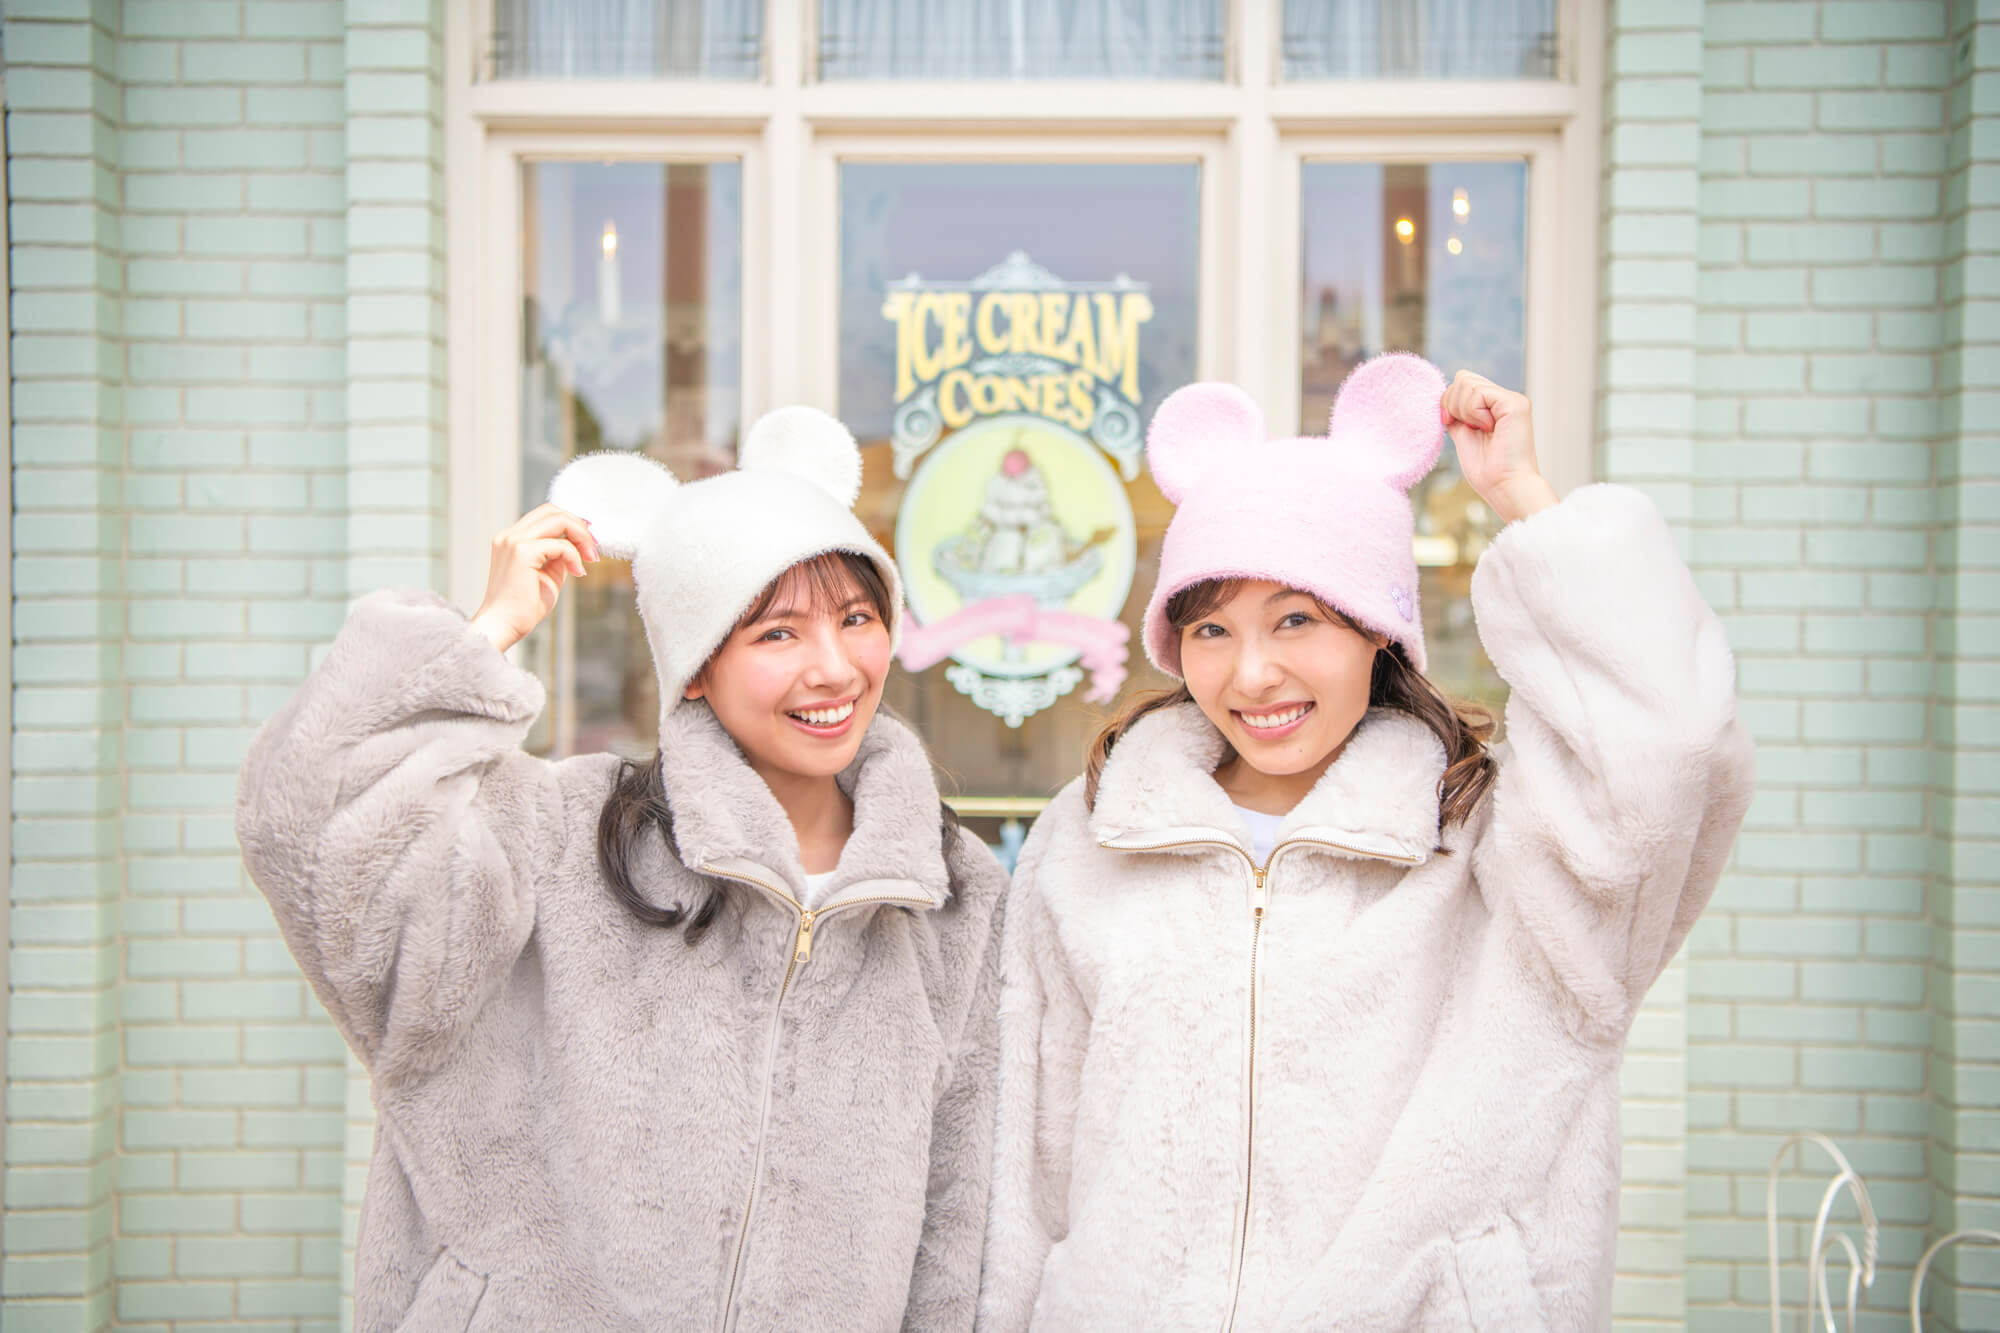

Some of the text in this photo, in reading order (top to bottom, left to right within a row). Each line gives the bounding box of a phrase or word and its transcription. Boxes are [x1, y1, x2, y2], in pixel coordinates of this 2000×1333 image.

[882, 292, 1153, 404] ICE CREAM
[938, 369, 1095, 431] CONES
